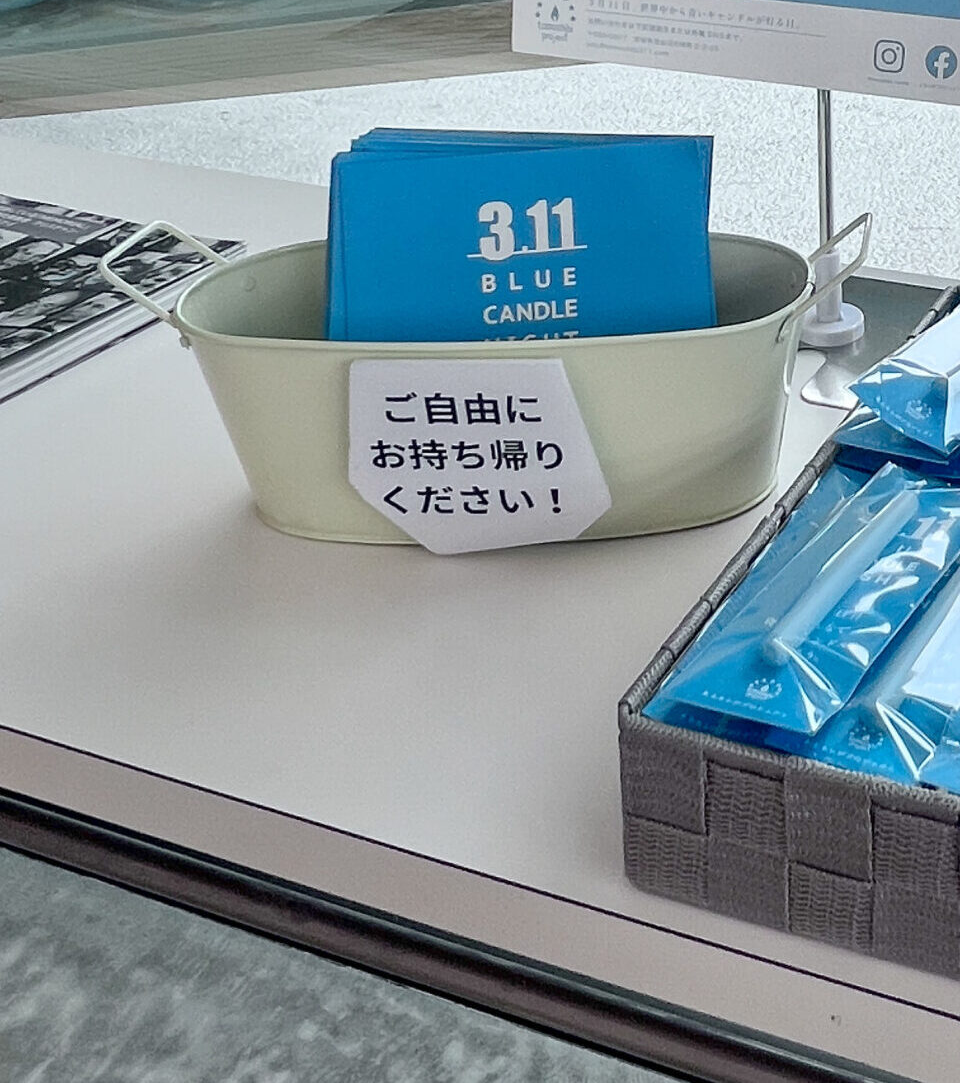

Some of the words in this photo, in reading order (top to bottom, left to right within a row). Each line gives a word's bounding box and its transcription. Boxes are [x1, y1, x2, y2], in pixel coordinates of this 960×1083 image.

[478, 197, 575, 261] 3.11
[481, 266, 577, 294] BLUE
[482, 298, 579, 325] CANDLE
[384, 392, 543, 426] ご自由に
[370, 438, 564, 472] お持ち帰り
